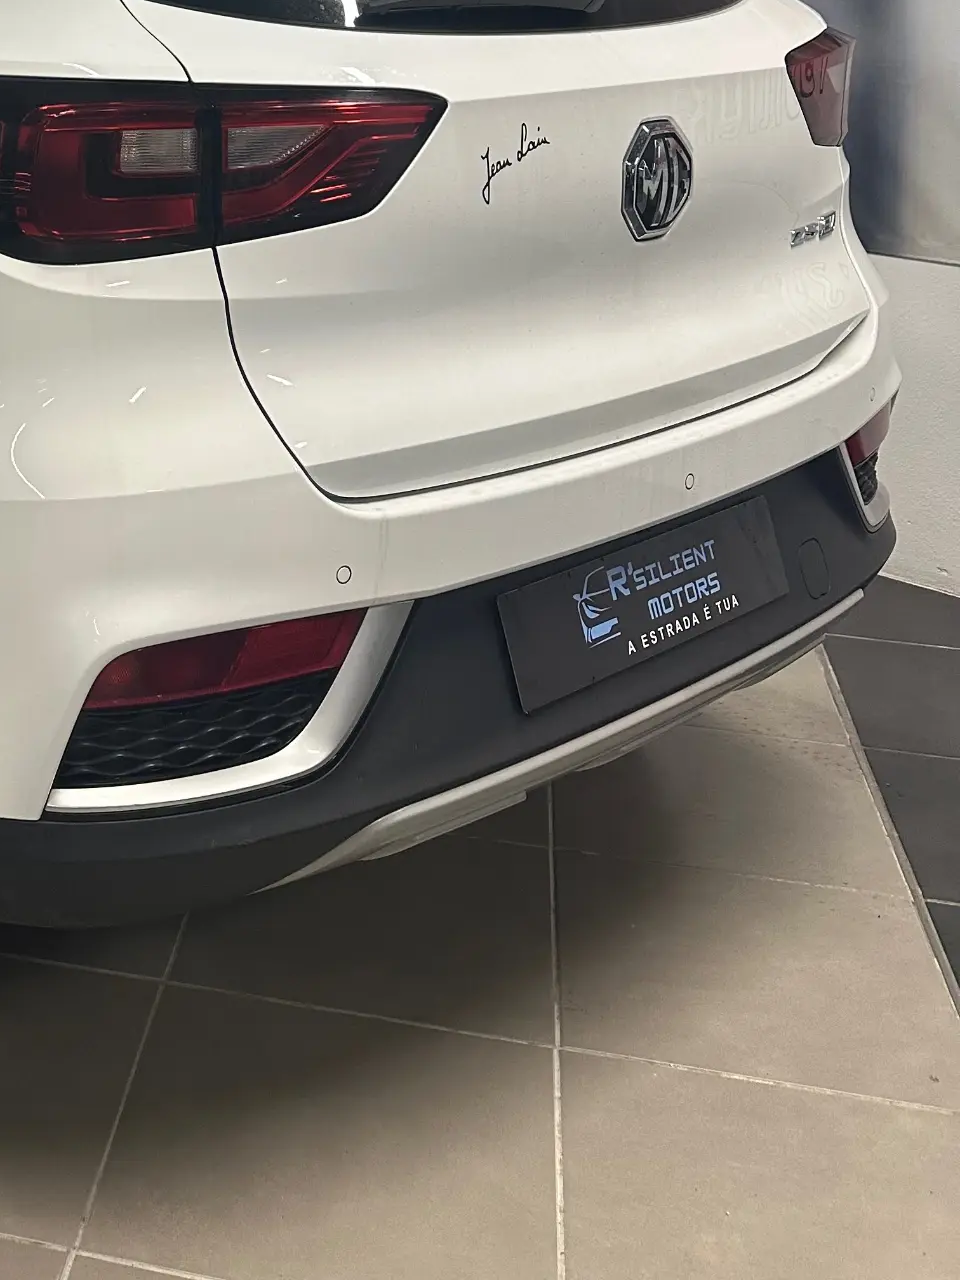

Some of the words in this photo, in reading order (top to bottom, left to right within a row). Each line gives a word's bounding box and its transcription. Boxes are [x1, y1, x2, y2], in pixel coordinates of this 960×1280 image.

[633, 132, 692, 230] MG
[606, 539, 715, 601] R'SILIENT
[647, 571, 721, 620] MOTORS
[627, 640, 637, 655] A
[640, 612, 701, 649] ESTRADA
[703, 603, 712, 621] É
[715, 594, 740, 615] TUA
